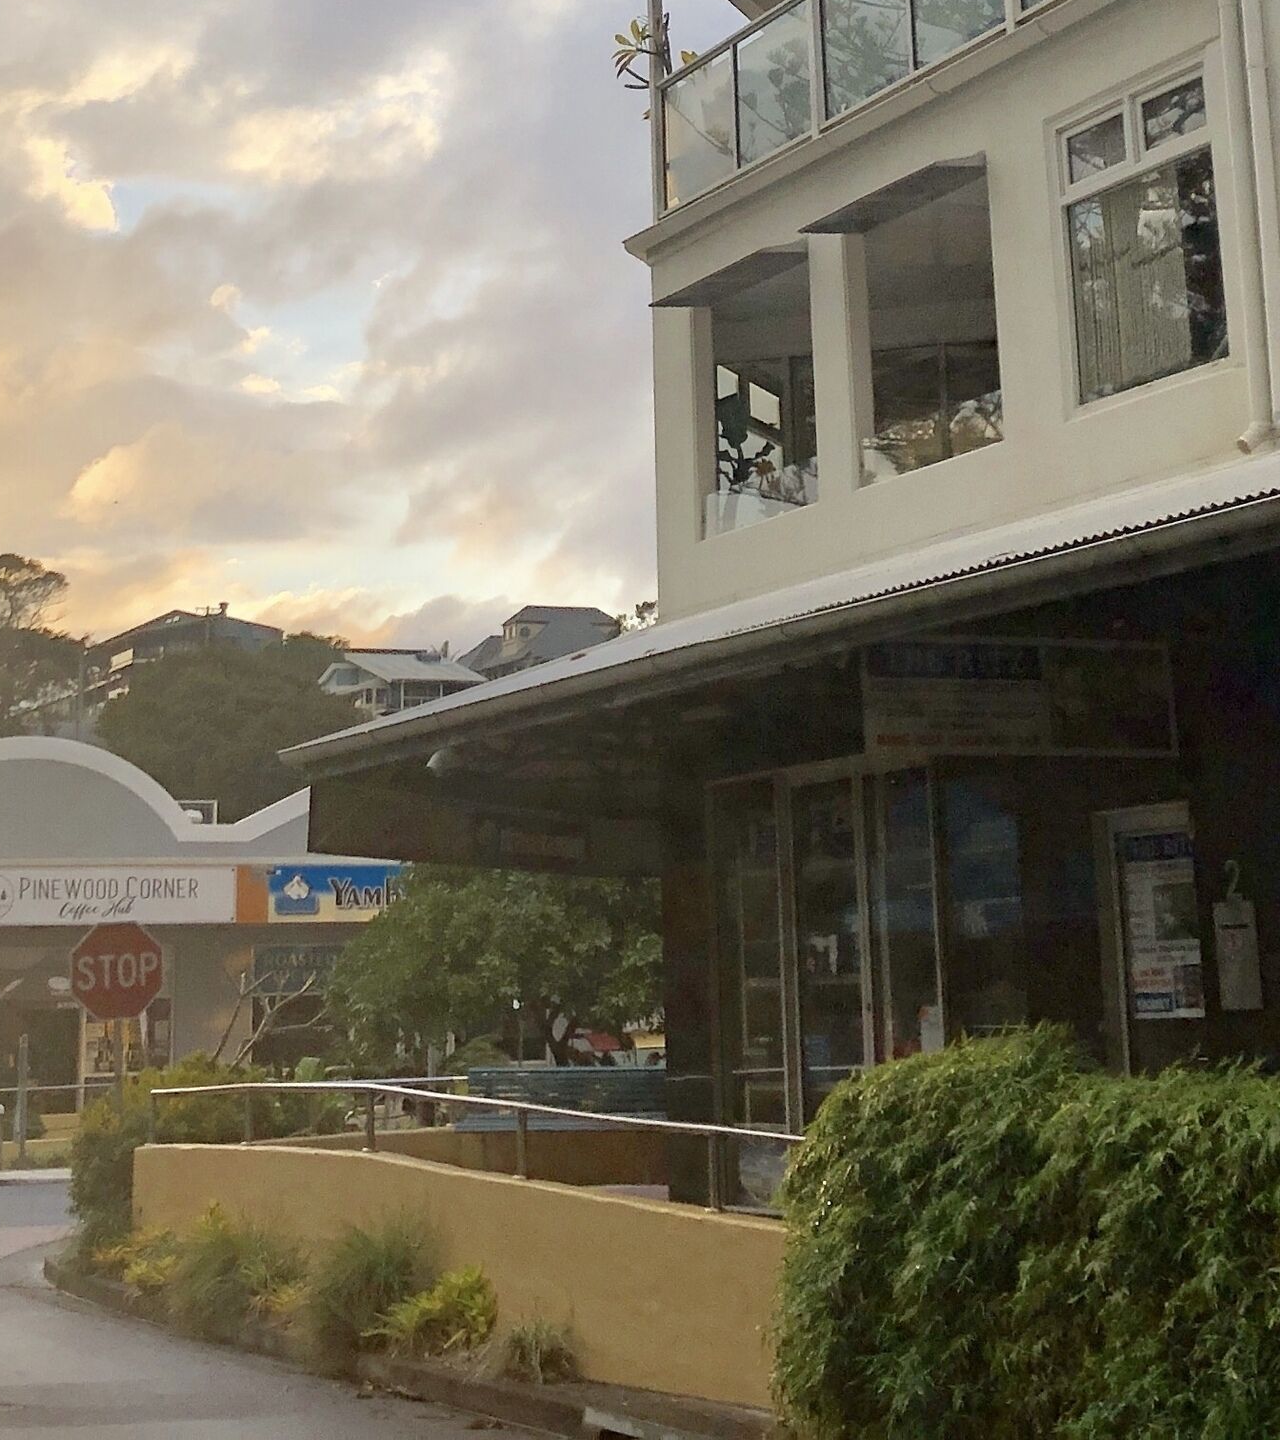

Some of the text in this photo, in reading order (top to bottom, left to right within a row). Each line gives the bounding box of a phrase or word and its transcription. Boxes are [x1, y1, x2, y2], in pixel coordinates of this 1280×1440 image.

[18, 875, 199, 900] PINEWOOD CORNER
[59, 897, 135, 920] Coffee Hub
[77, 951, 159, 991] STOP
